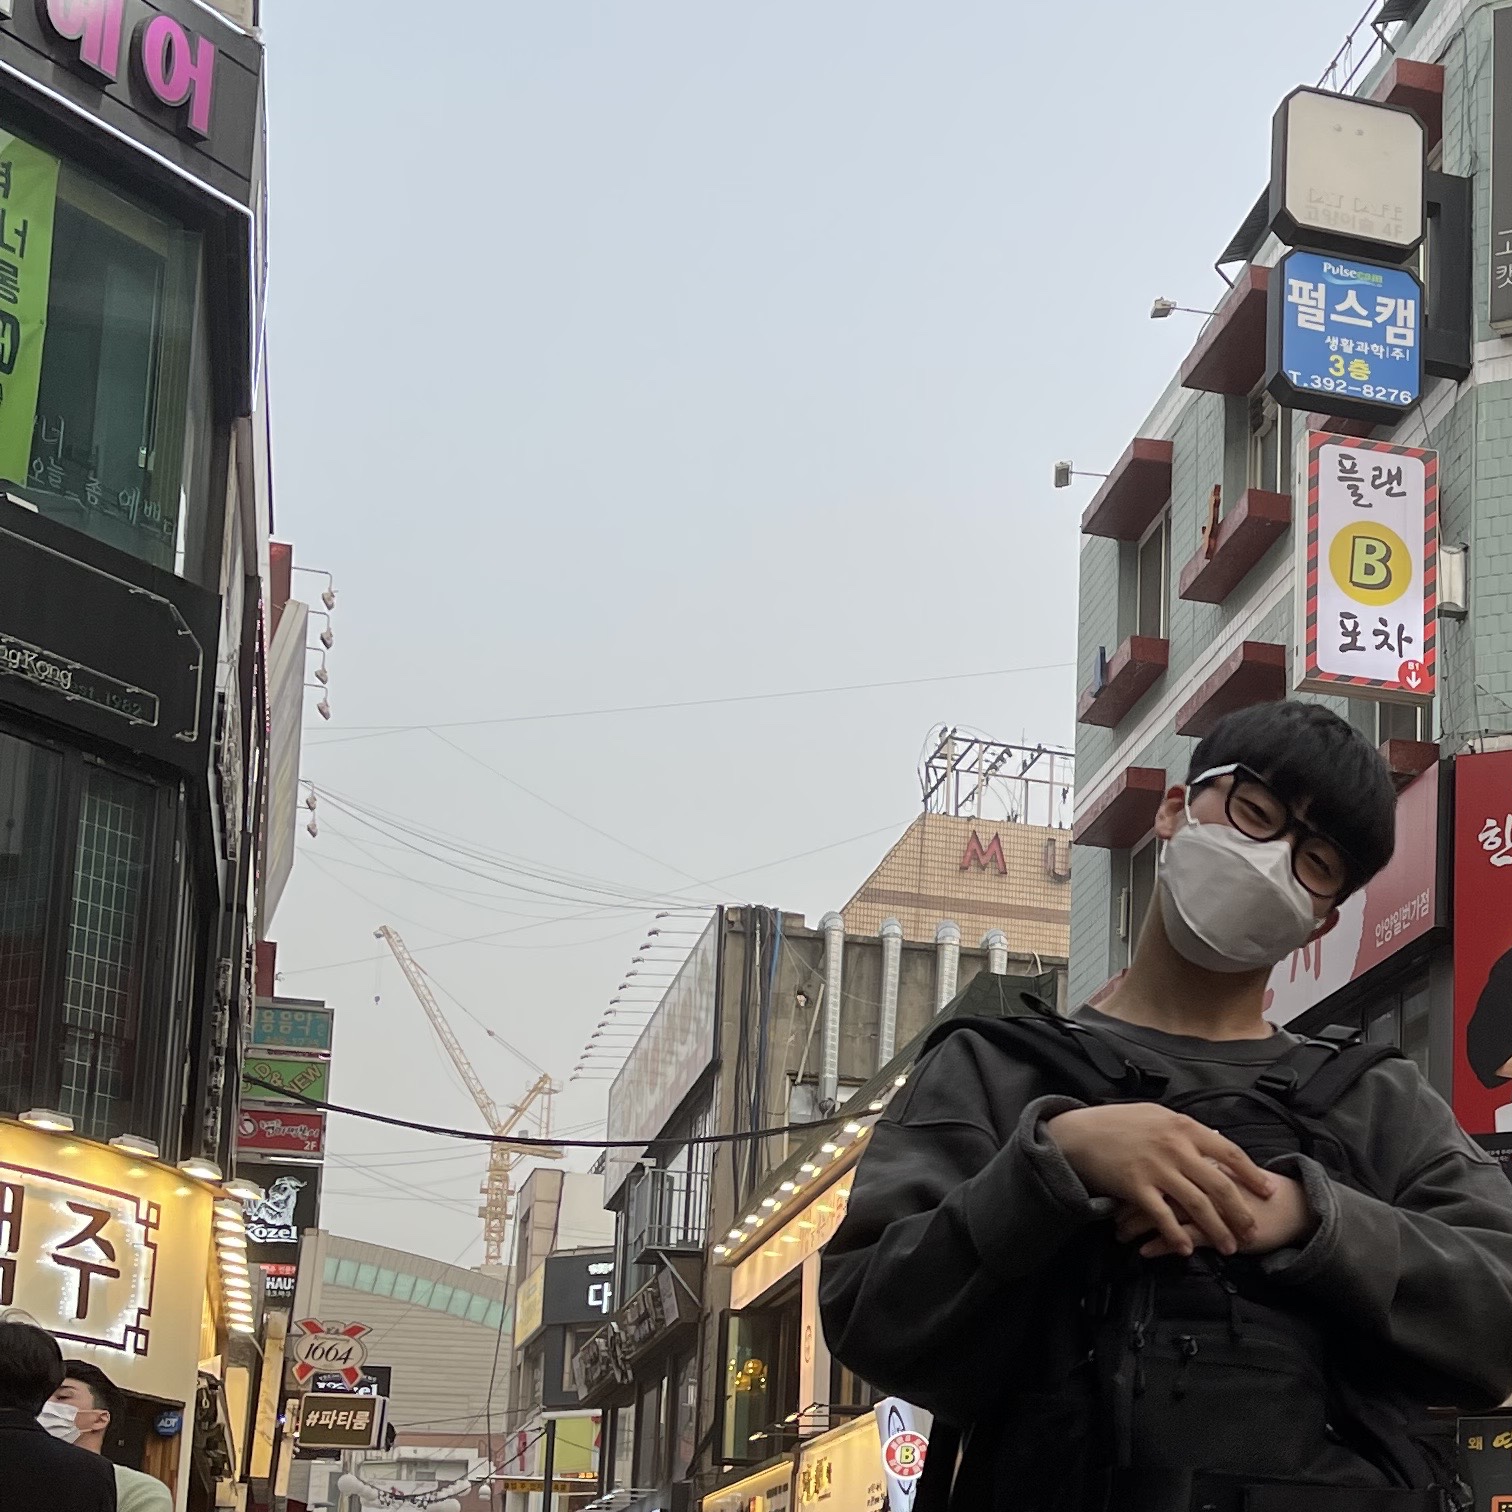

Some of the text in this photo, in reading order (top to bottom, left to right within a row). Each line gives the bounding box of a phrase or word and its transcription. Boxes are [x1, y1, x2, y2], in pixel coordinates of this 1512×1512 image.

[1287, 278, 1415, 348] 펄스캠
[1288, 369, 1412, 405] T.392-8276
[1337, 453, 1407, 508] 플랜
[1349, 535, 1392, 590] B
[1339, 611, 1413, 659] 포차
[304, 1342, 355, 1365] 1664
[157, 1416, 179, 1431] ADT
[306, 1409, 371, 1431] #파티룸
[899, 1445, 915, 1464] B
